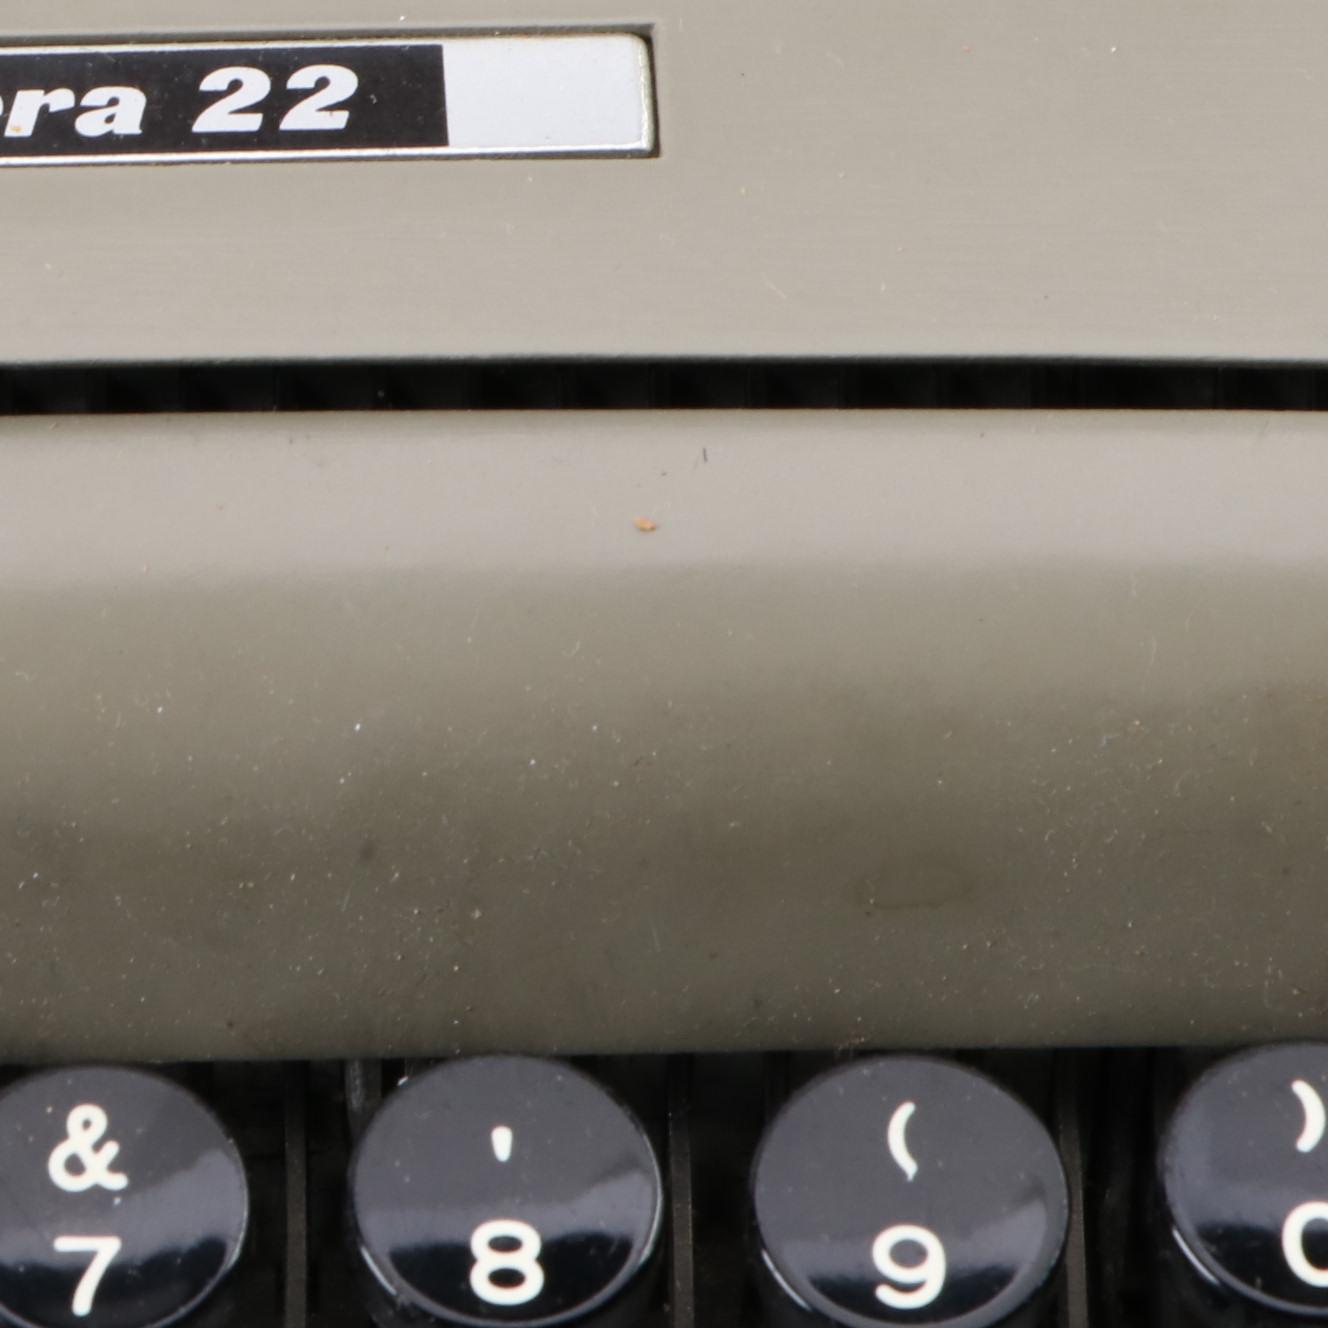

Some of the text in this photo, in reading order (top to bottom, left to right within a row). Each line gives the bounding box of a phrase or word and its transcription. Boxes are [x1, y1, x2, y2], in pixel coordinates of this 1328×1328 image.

[191, 64, 360, 133] 22
[47, 1103, 129, 1193] &
[886, 1101, 919, 1182] (
[1290, 1079, 1327, 1153] )
[52, 1235, 123, 1317] 7
[469, 1219, 545, 1305] 8
[870, 1224, 948, 1309] 9
